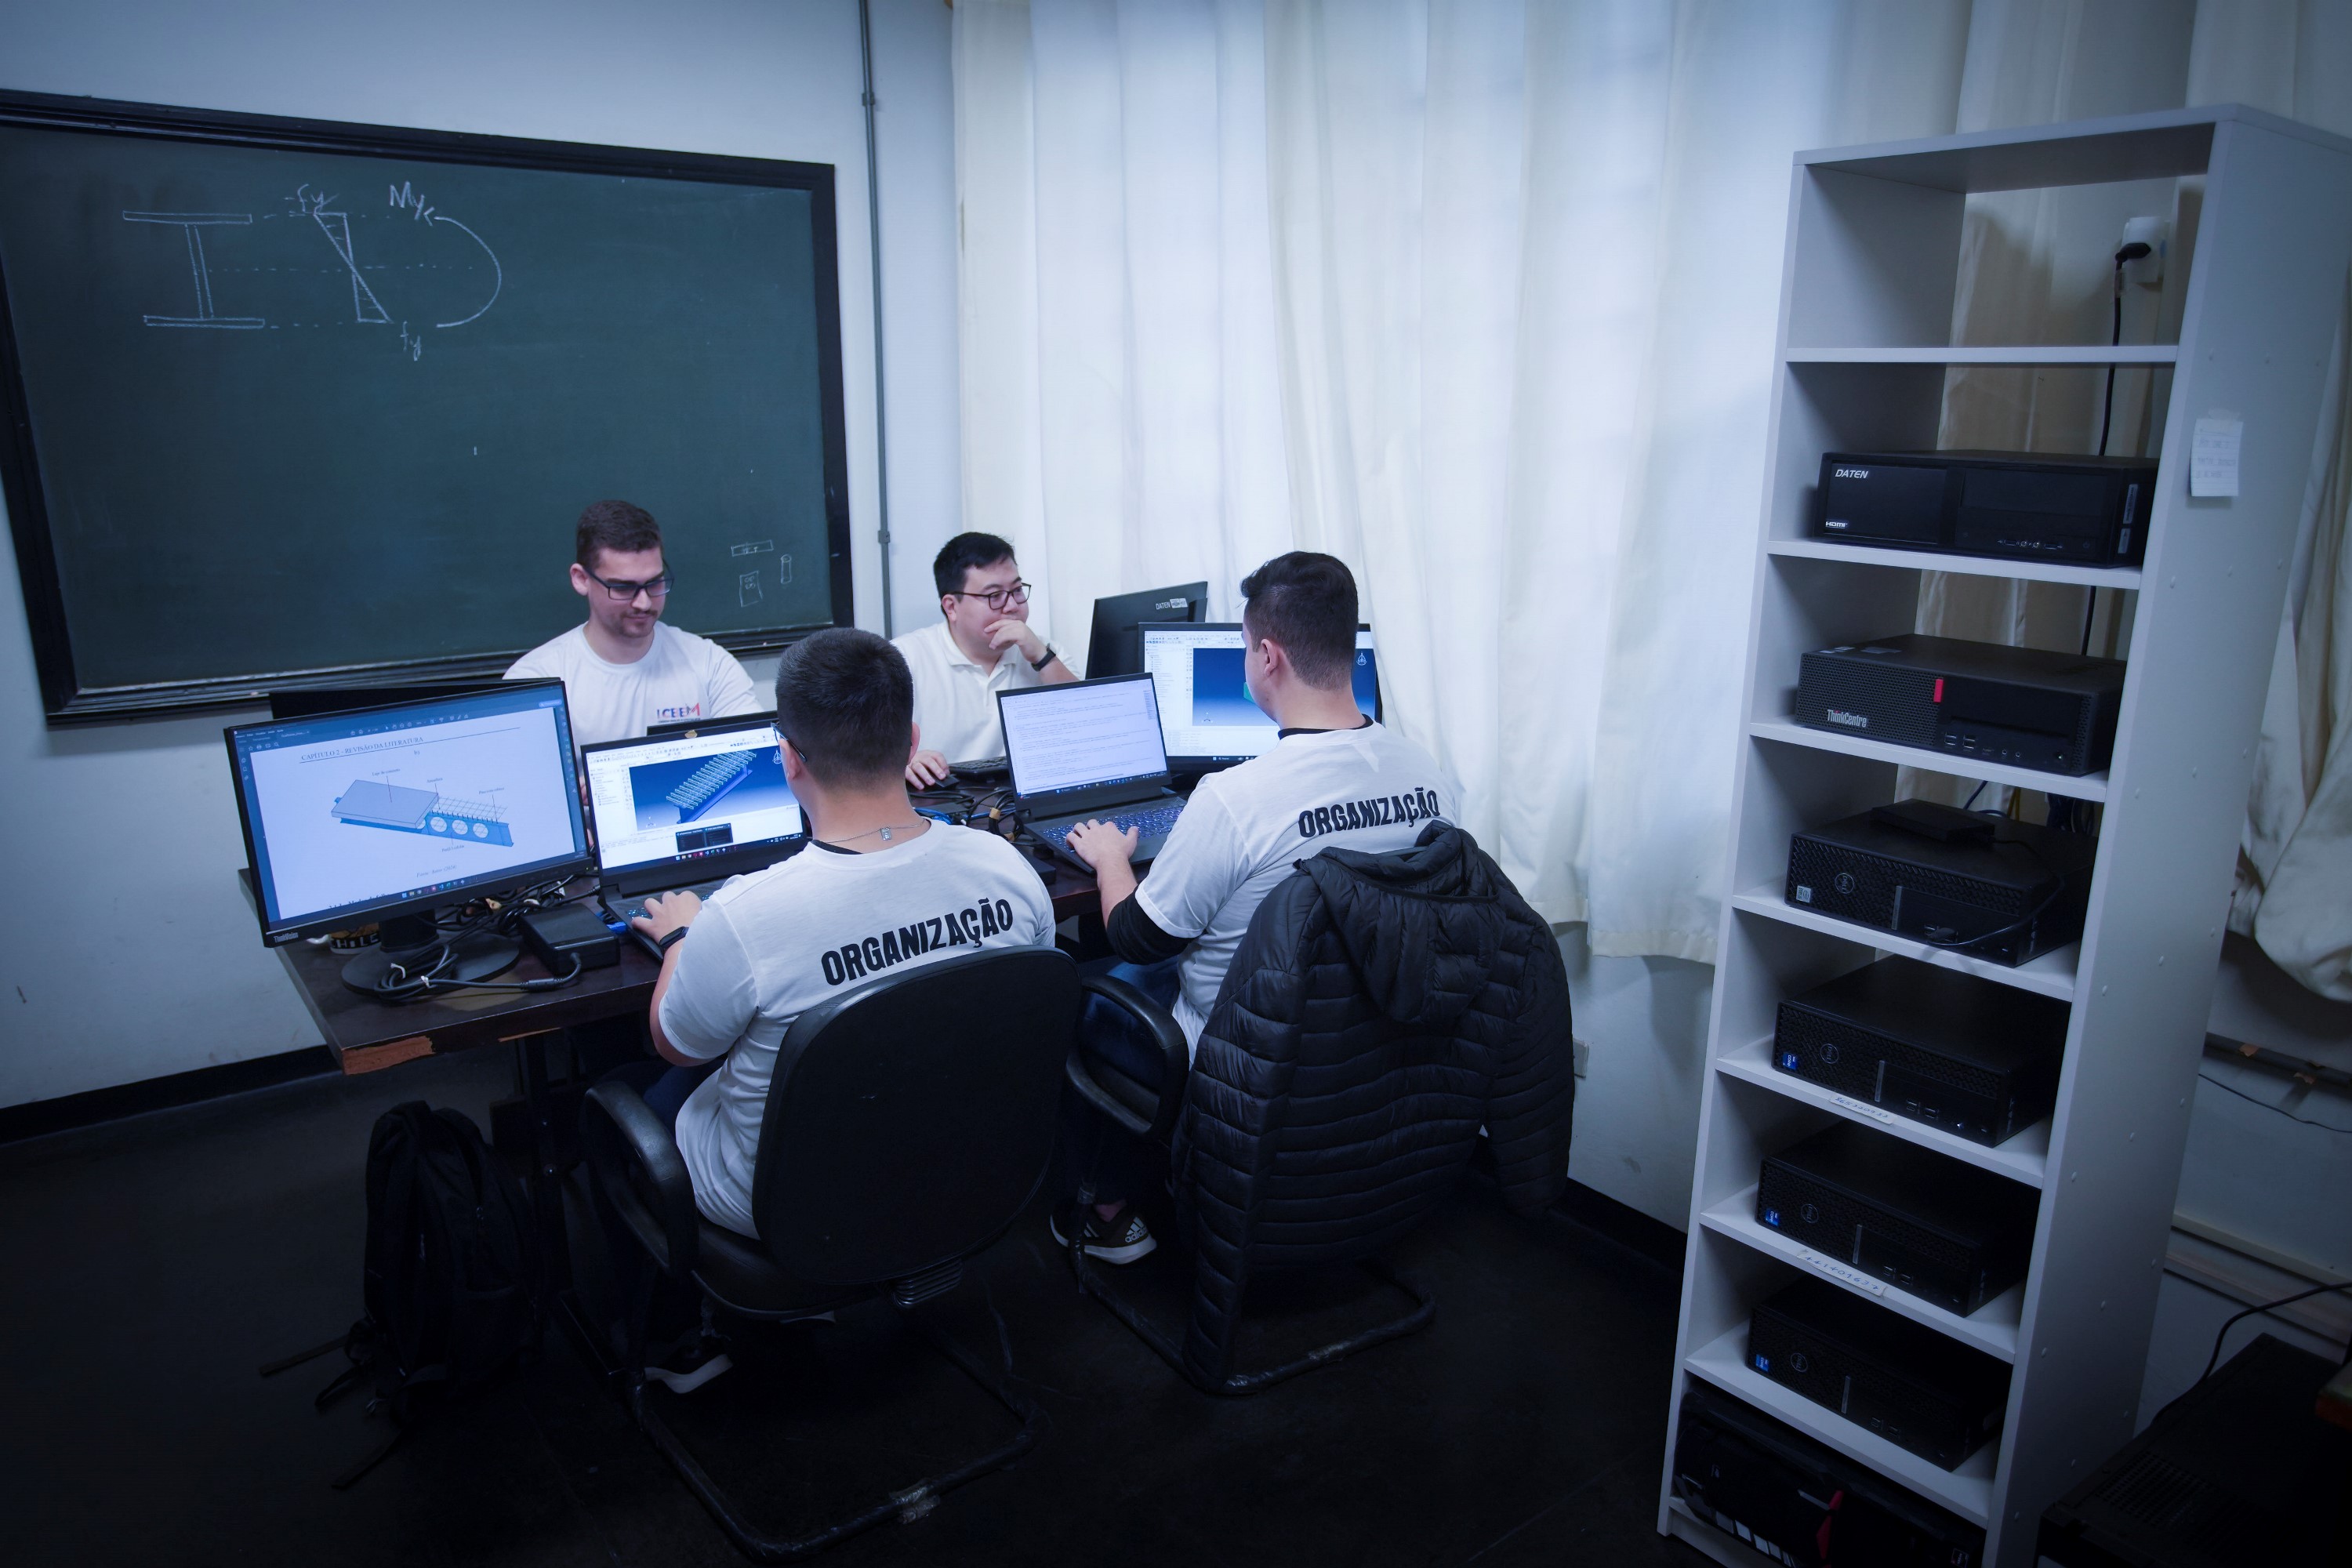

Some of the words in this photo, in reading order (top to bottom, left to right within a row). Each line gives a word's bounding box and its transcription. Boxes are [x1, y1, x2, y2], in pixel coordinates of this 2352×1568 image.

[1835, 469, 1868, 479] DATEN
[1155, 601, 1171, 610] DATEN
[1827, 709, 1867, 728] ThinkCentre
[301, 750, 335, 760] CAPÍTULO
[344, 743, 373, 754] REVISÃO
[384, 736, 423, 748] LITERATURA
[1298, 786, 1441, 838] ORGANIZAÇÃO
[821, 897, 1014, 986] ORGANIZAÇÃO
